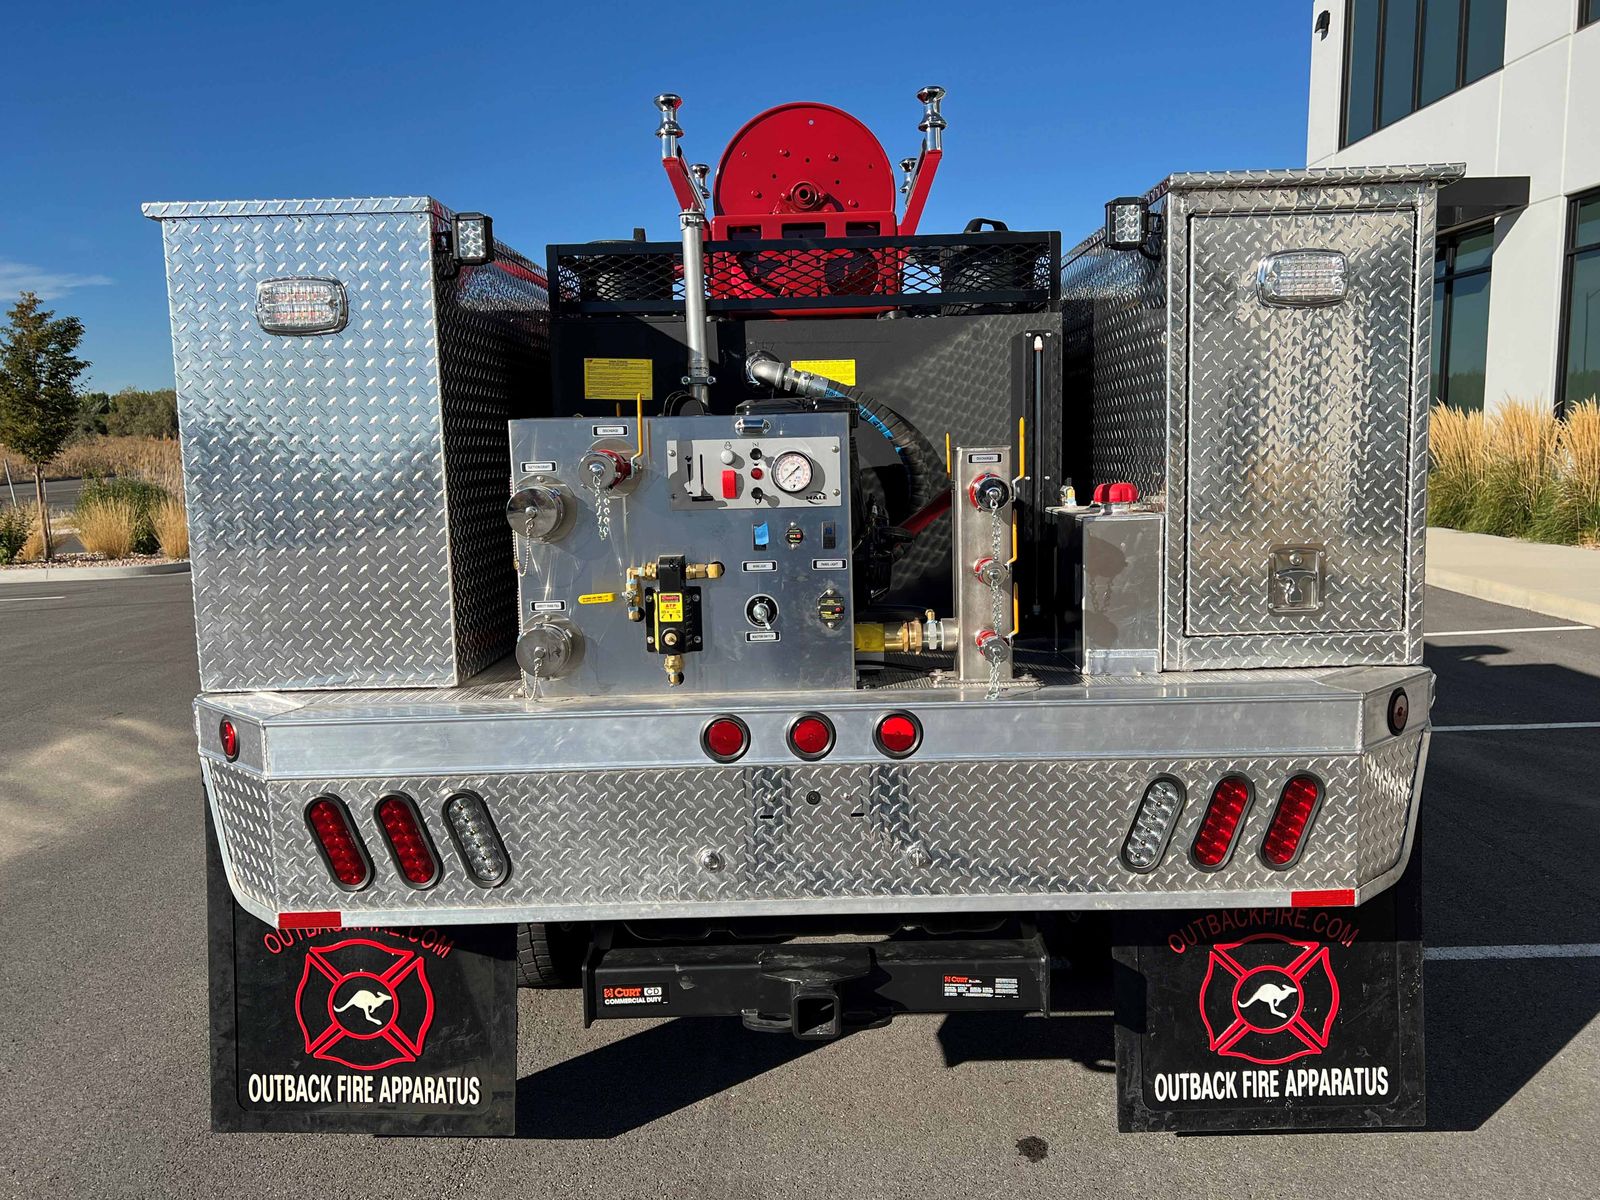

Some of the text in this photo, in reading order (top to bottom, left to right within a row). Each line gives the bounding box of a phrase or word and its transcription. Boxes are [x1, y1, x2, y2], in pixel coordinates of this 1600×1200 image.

[1168, 907, 1360, 954] OUTBACKFIRE.COM
[604, 997, 646, 1005] COMMERCIAL
[614, 988, 642, 997] CURT
[248, 1073, 481, 1105] OUTBACK FIRE APPARATUS
[1154, 1066, 1389, 1102] OUTBACK FIRE APPARATUS
